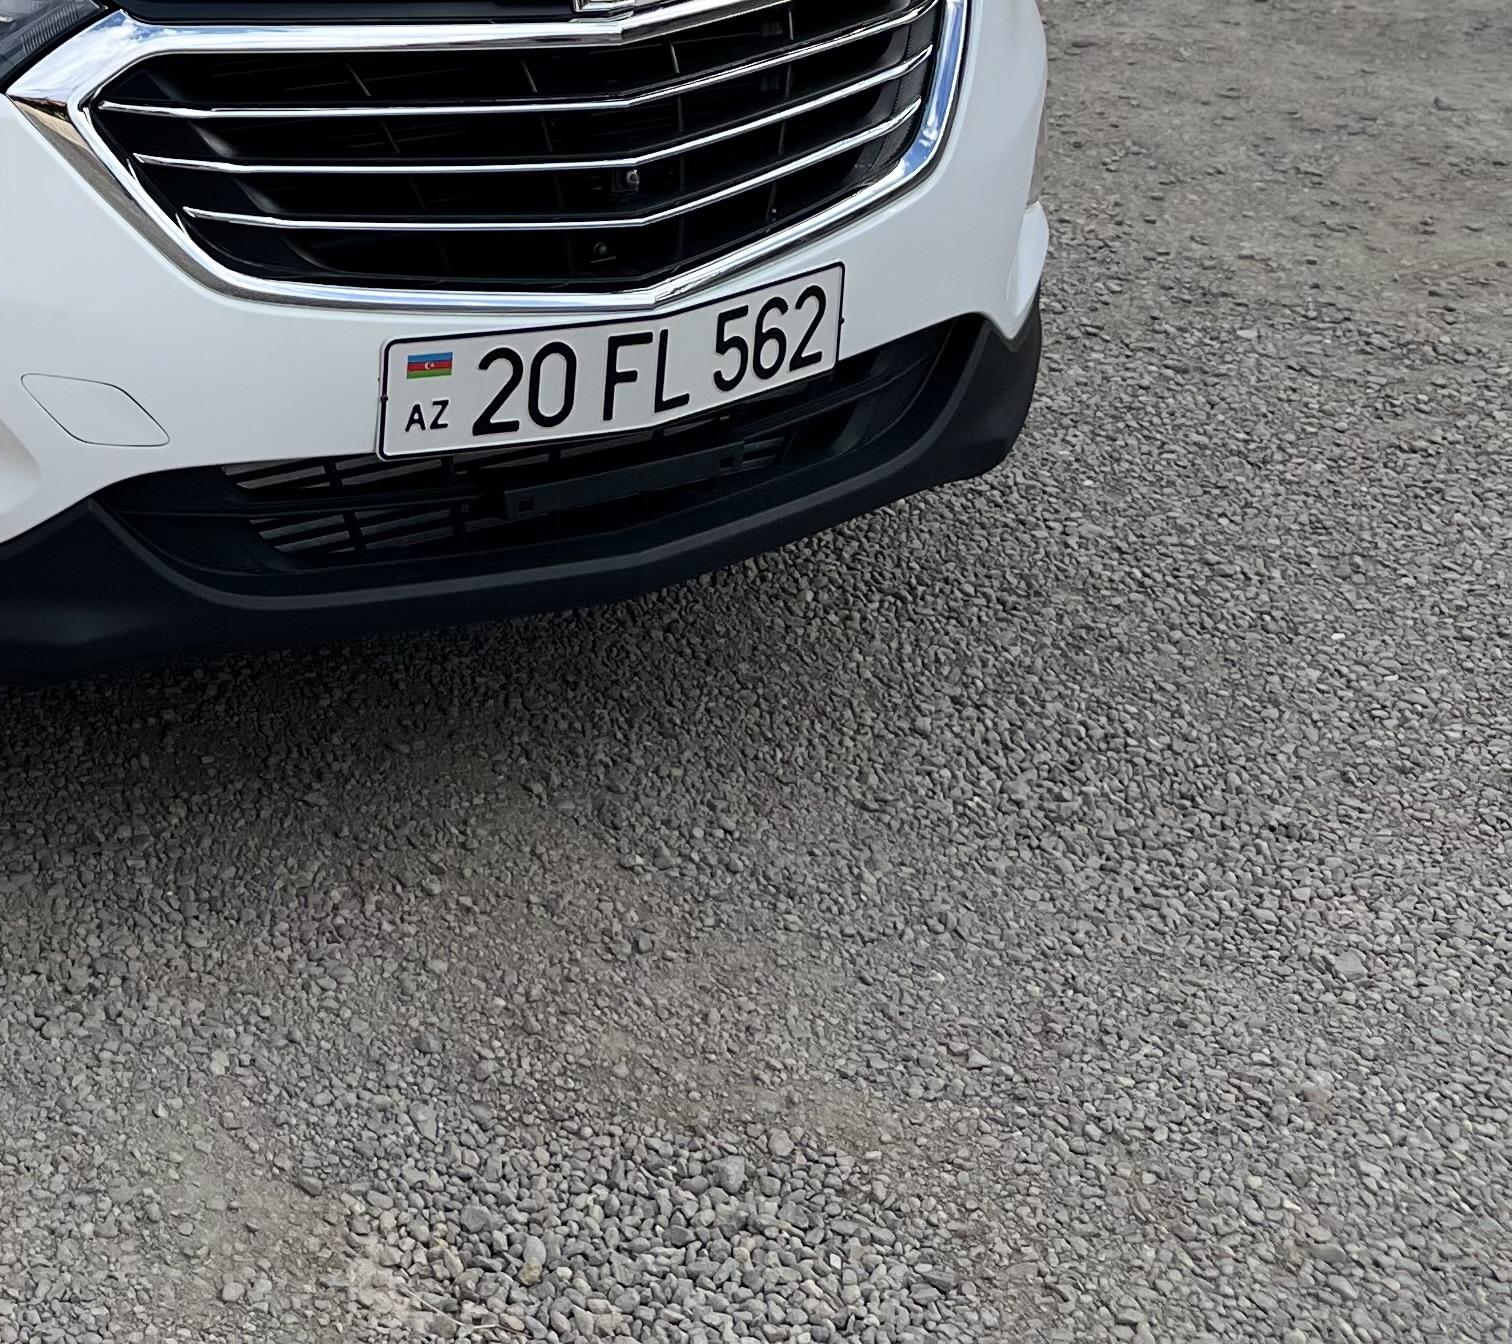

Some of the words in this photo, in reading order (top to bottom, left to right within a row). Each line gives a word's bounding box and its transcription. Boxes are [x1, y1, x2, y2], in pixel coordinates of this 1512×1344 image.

[404, 400, 449, 433] AZ
[472, 341, 577, 436] 20
[602, 329, 690, 421] FL
[713, 285, 827, 392] 562
